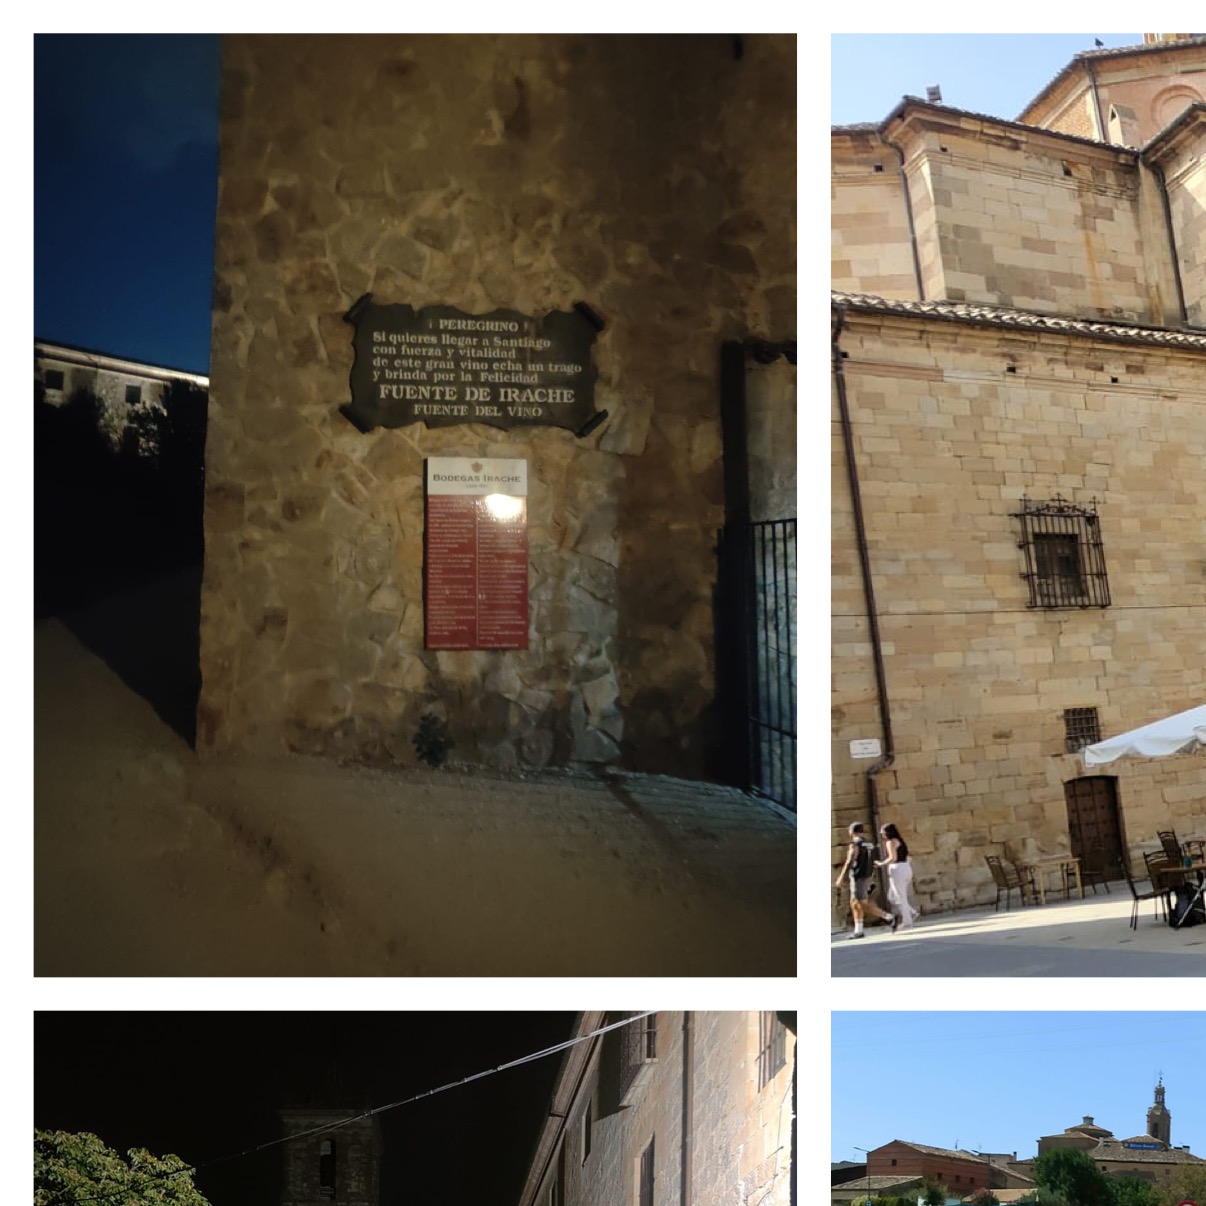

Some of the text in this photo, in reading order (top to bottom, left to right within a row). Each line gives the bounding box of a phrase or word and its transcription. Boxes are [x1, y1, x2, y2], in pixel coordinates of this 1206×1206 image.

[439, 319, 519, 332] PEREGRINO
[373, 331, 386, 342] Si
[389, 332, 438, 345] quieres
[441, 334, 479, 348] llegar
[493, 336, 551, 351] Santiago
[373, 344, 516, 359] con fuerza y vitalidad
[373, 357, 582, 375] de este gran vino echa un trago
[373, 369, 539, 383] y brinda por la Felicidad
[379, 384, 575, 403] FUENTE DE IRACHE
[414, 404, 543, 417] FUENTE DEL VINO
[433, 474, 521, 483] BODEGAS IRACHE
